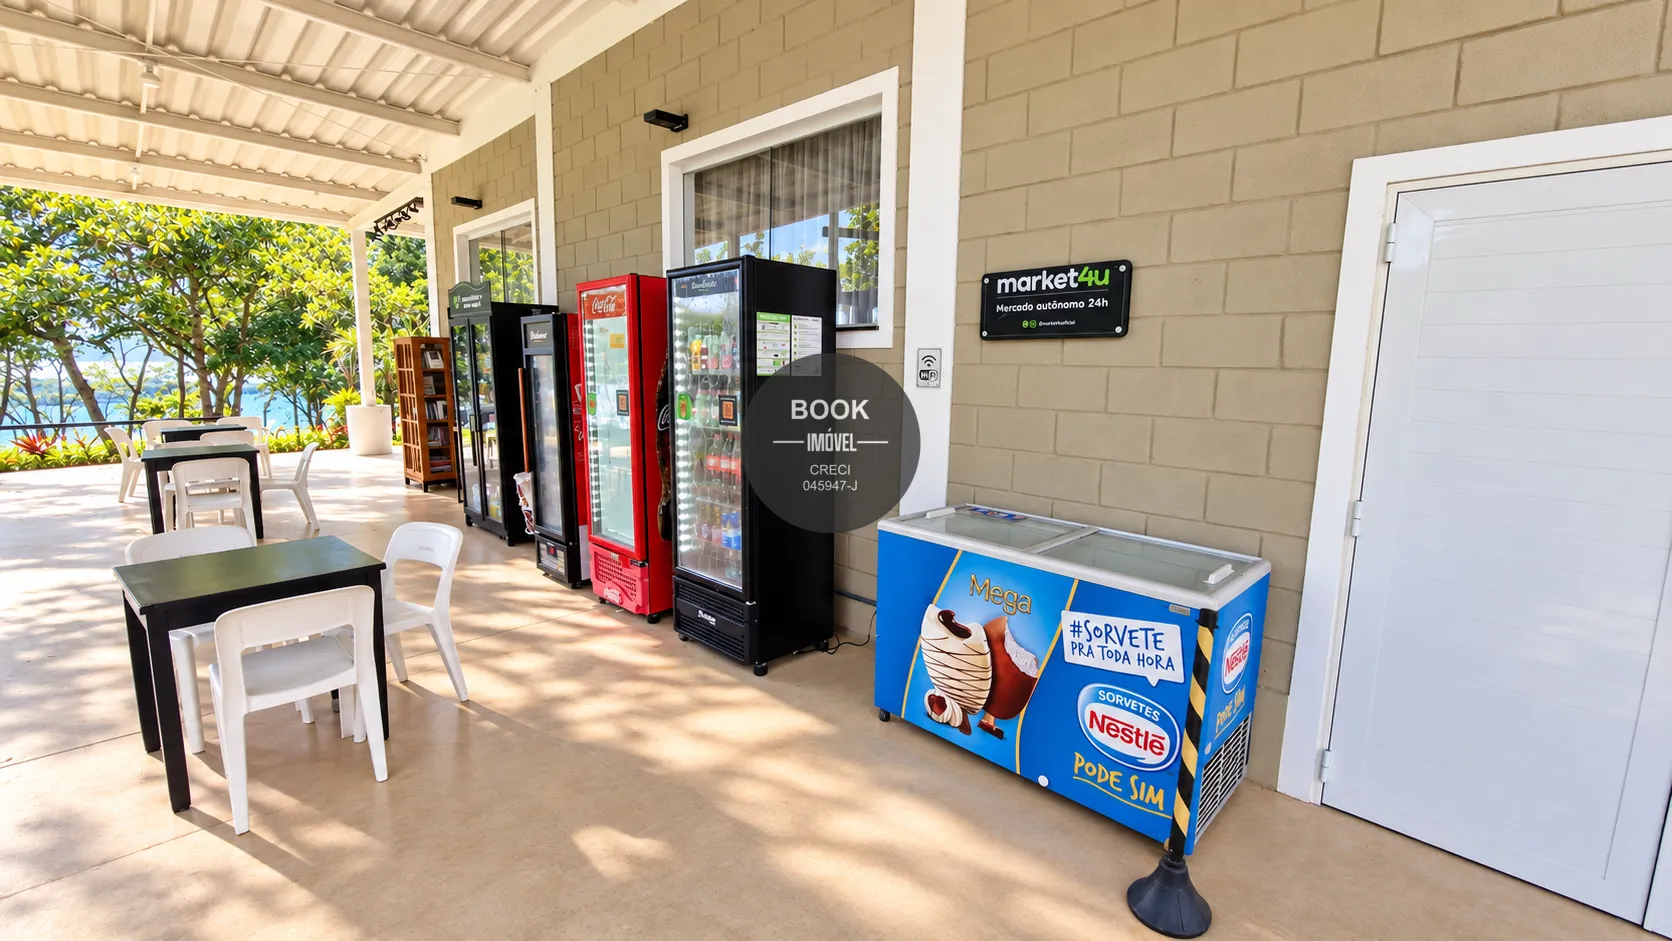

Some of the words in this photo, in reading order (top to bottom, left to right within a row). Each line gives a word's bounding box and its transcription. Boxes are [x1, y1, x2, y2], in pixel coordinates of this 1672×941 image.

[997, 266, 1110, 294] market4u
[996, 303, 1033, 313] Mercado
[1036, 300, 1085, 311] autônomo
[1088, 297, 1109, 308] 24h
[969, 573, 1032, 615] Mega
[1070, 619, 1165, 651] #SORVETE
[1071, 641, 1095, 658] PRA
[1097, 645, 1131, 665] TODA
[1136, 653, 1175, 671] HORA
[1098, 690, 1160, 722] SORVETES
[1089, 710, 1166, 756] Nestlé
[1073, 752, 1123, 792] PODE
[1130, 774, 1165, 811] SIM
